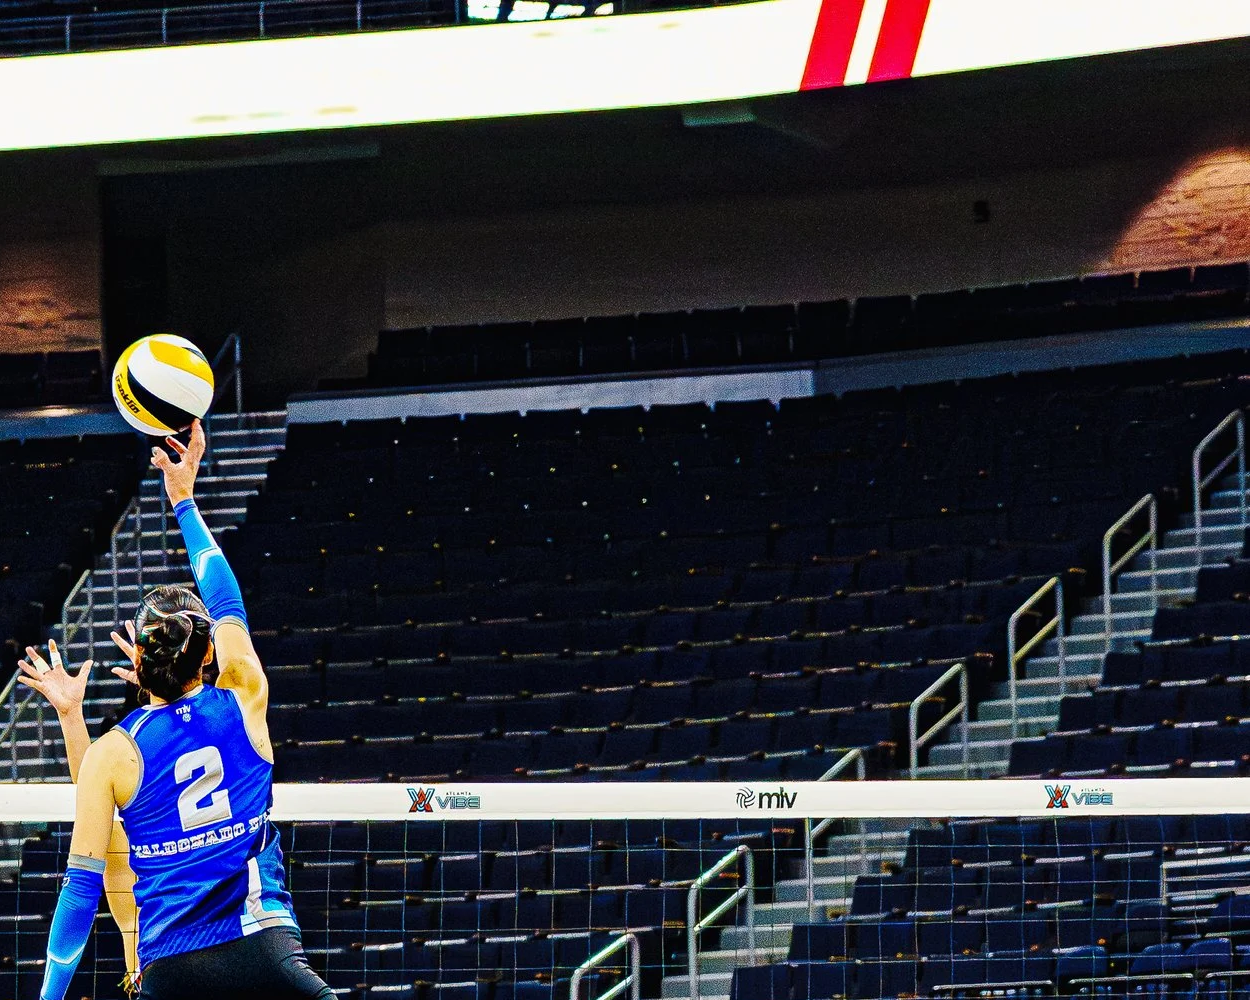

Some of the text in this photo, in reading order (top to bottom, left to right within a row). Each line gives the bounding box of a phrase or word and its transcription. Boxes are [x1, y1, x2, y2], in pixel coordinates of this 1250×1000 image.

[174, 745, 233, 832] 2
[758, 786, 798, 809] mlv
[435, 796, 481, 809] VIBE
[1071, 792, 1113, 805] VIBE
